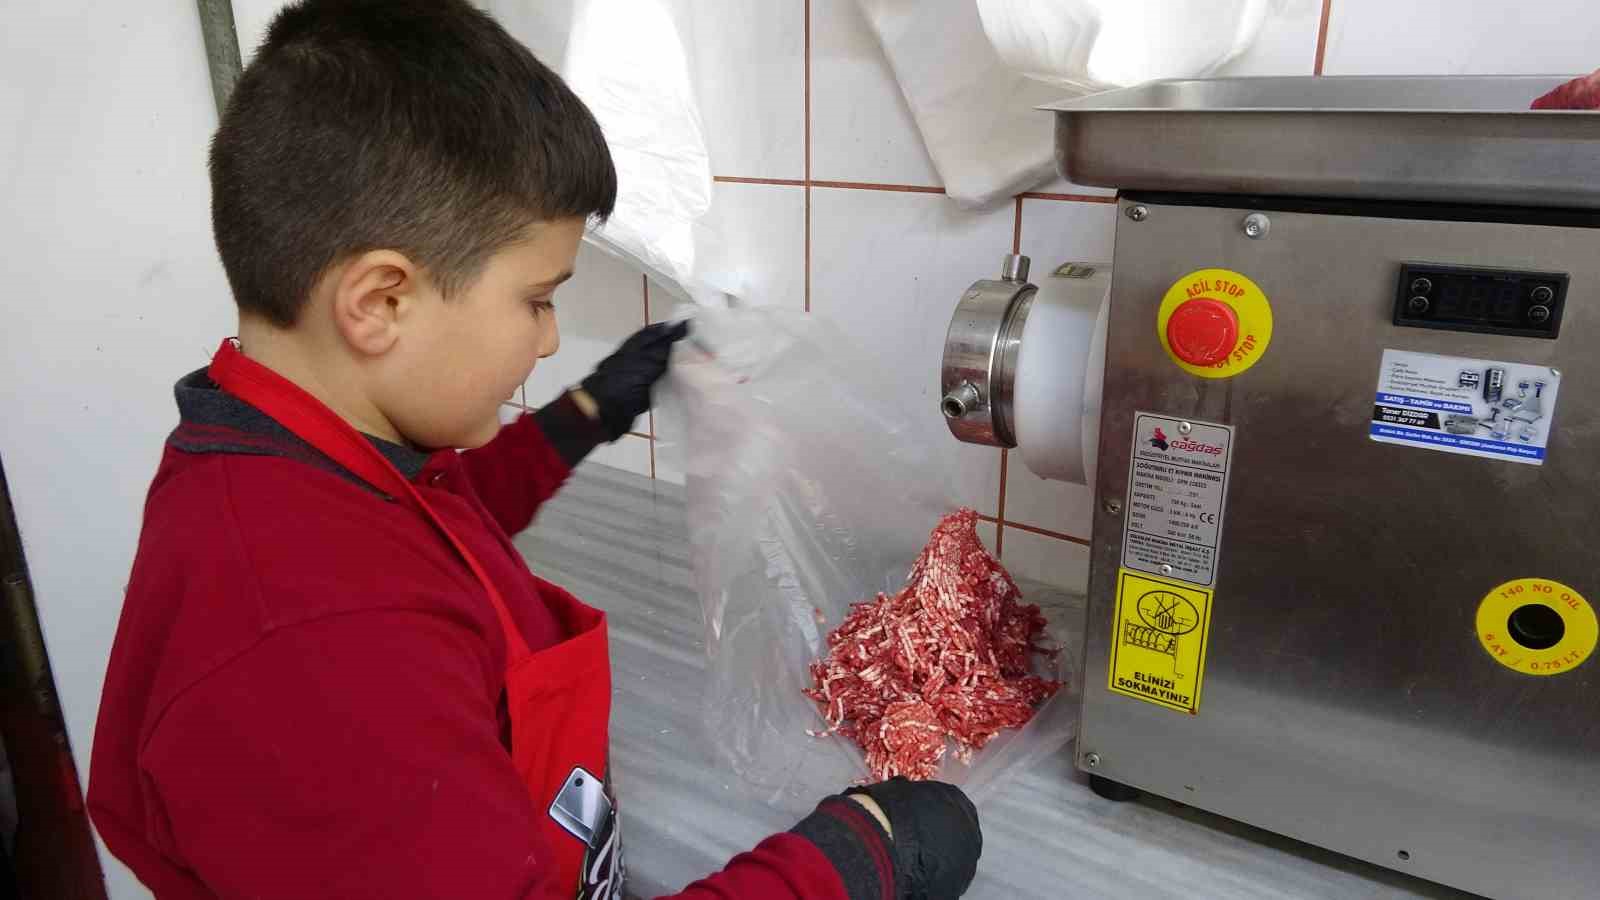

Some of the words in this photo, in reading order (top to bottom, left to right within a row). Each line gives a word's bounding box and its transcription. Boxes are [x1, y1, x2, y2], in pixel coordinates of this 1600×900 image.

[1214, 279, 1246, 297] STOP
[1233, 334, 1257, 361] STOP
[1501, 585, 1524, 599] 140
[1532, 584, 1552, 593] NO
[1134, 671, 1175, 690] ELİNİZİ
[1118, 678, 1190, 704] SOKMAYINIZ
